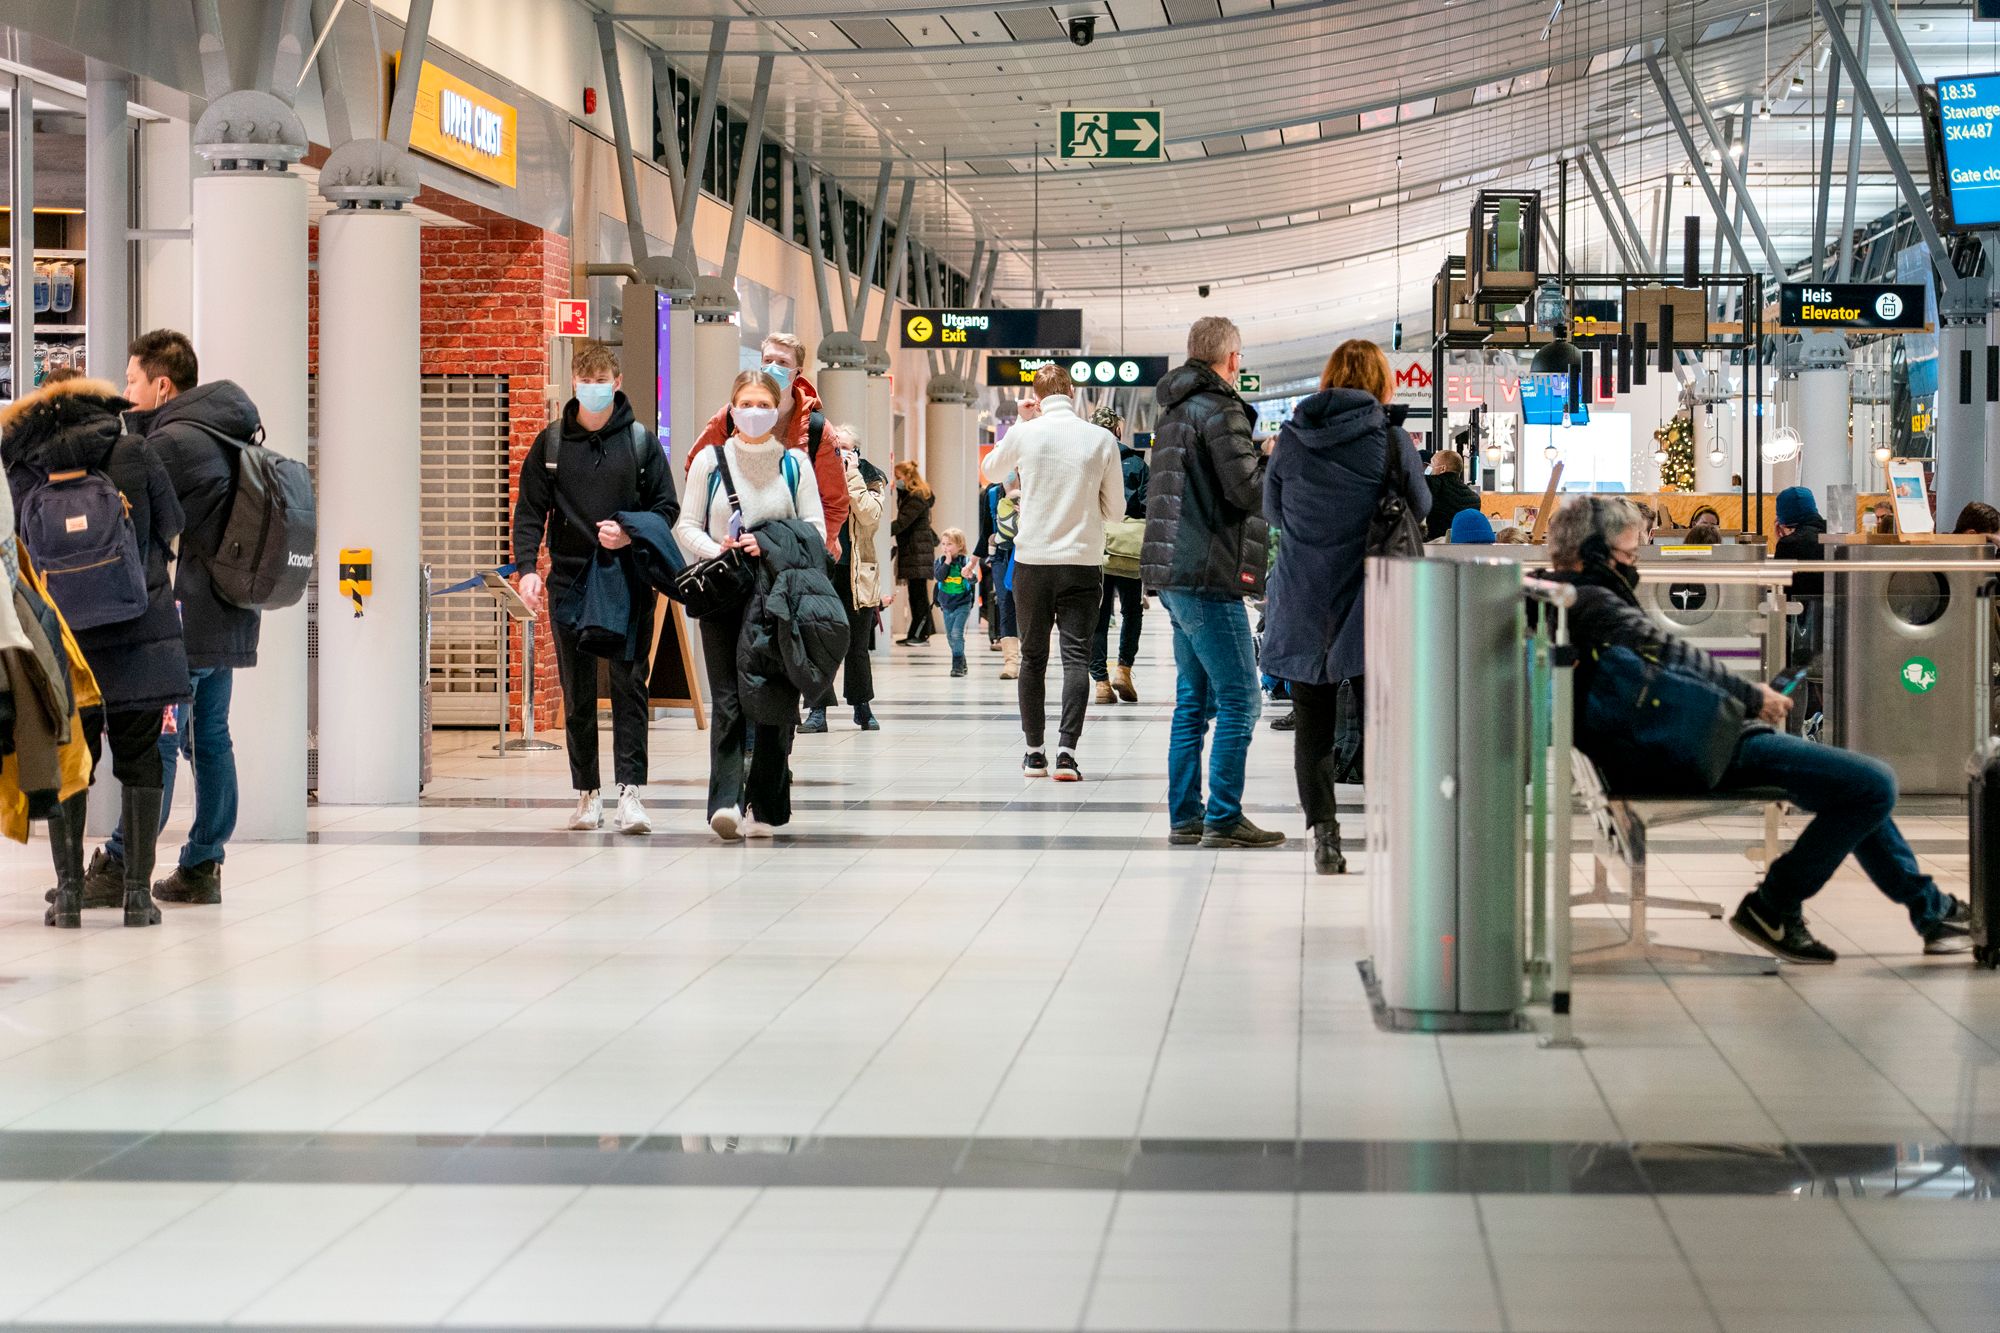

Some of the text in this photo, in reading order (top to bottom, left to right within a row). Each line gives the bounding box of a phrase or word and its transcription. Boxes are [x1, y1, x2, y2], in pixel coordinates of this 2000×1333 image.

[1941, 83, 1977, 101] 18:35
[442, 89, 502, 156] UPPER CRUST
[1946, 122, 1993, 141] SK4487
[1951, 168, 1981, 183] Gate
[1802, 288, 1833, 303] Heis
[941, 313, 989, 330] Utgang
[1801, 305, 1861, 321] Elevator
[941, 329, 967, 343] Exit
[1396, 362, 1433, 387] MAX
